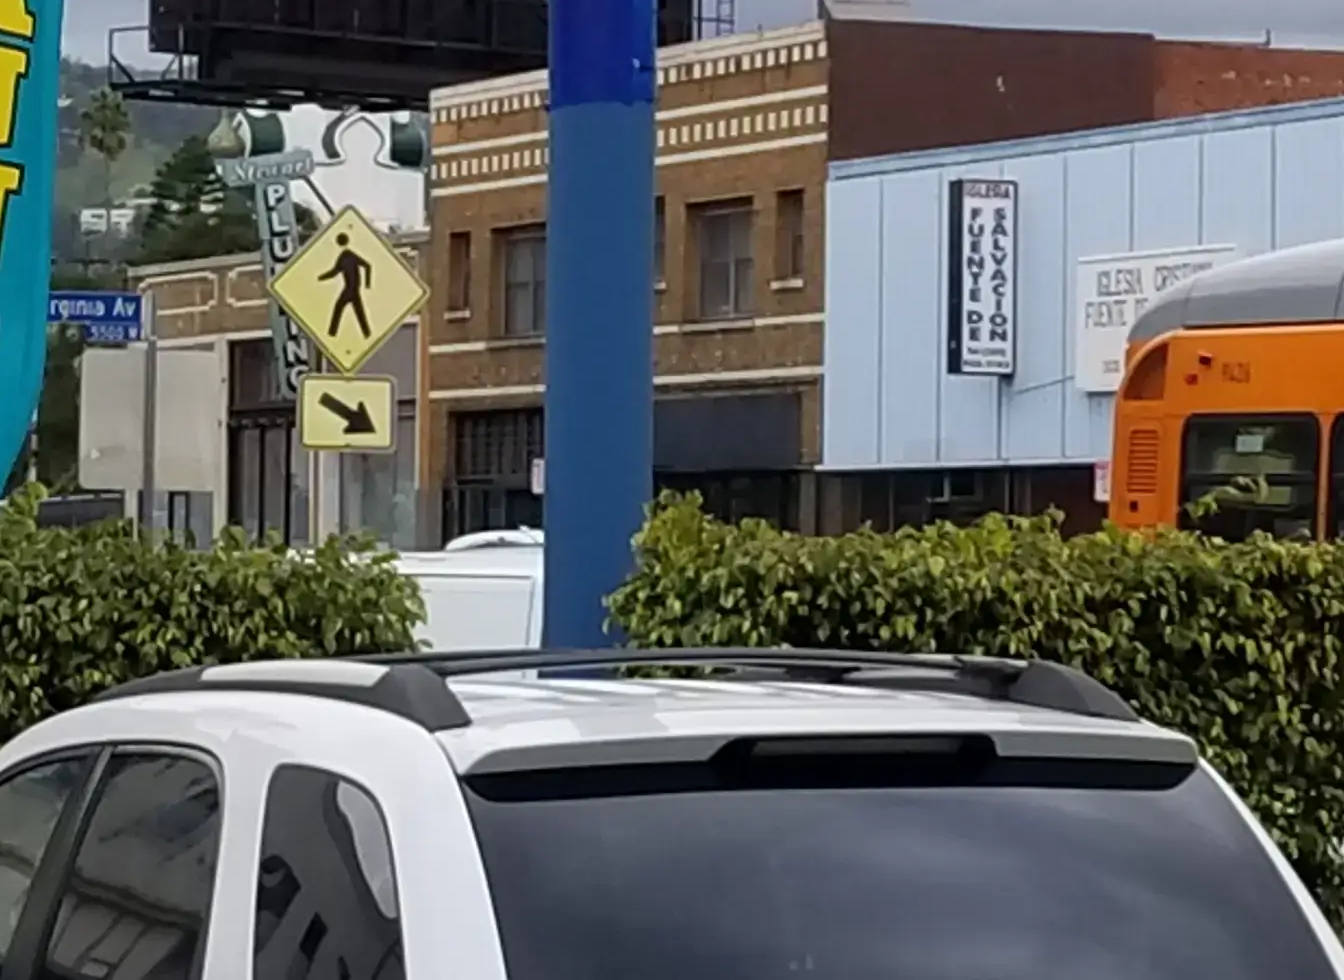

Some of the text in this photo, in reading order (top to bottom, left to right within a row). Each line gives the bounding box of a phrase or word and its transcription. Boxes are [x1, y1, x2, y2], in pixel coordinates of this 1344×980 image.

[112, 297, 136, 317] Av
[966, 207, 986, 341] FUENTE DE
[989, 207, 1009, 342] SALVACION
